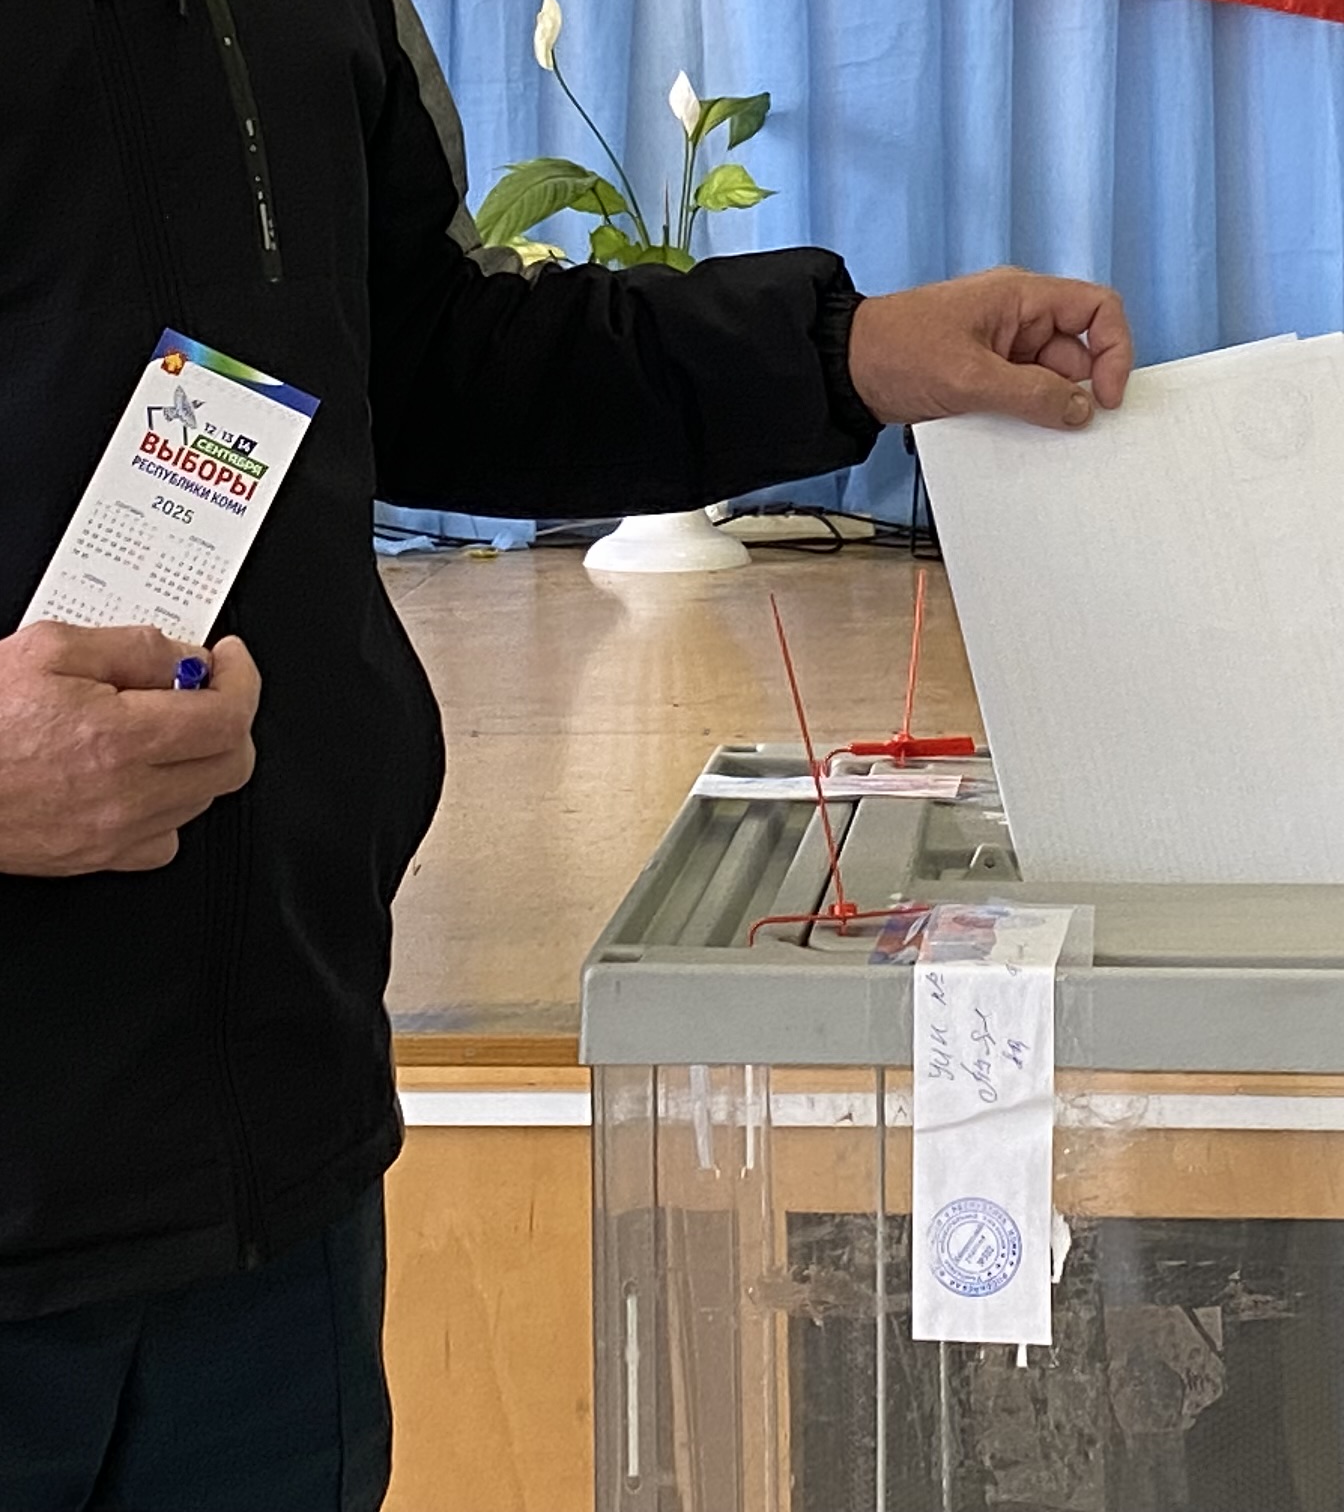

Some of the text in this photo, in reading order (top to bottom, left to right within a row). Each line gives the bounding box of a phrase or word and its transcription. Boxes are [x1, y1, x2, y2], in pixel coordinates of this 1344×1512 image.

[139, 431, 258, 501] ВЫБОРЫ
[196, 437, 264, 476] СЕНТЯБРЯ
[131, 454, 248, 517] РЕСПУБЛИКИ КОМИ
[151, 495, 195, 524] 2025
